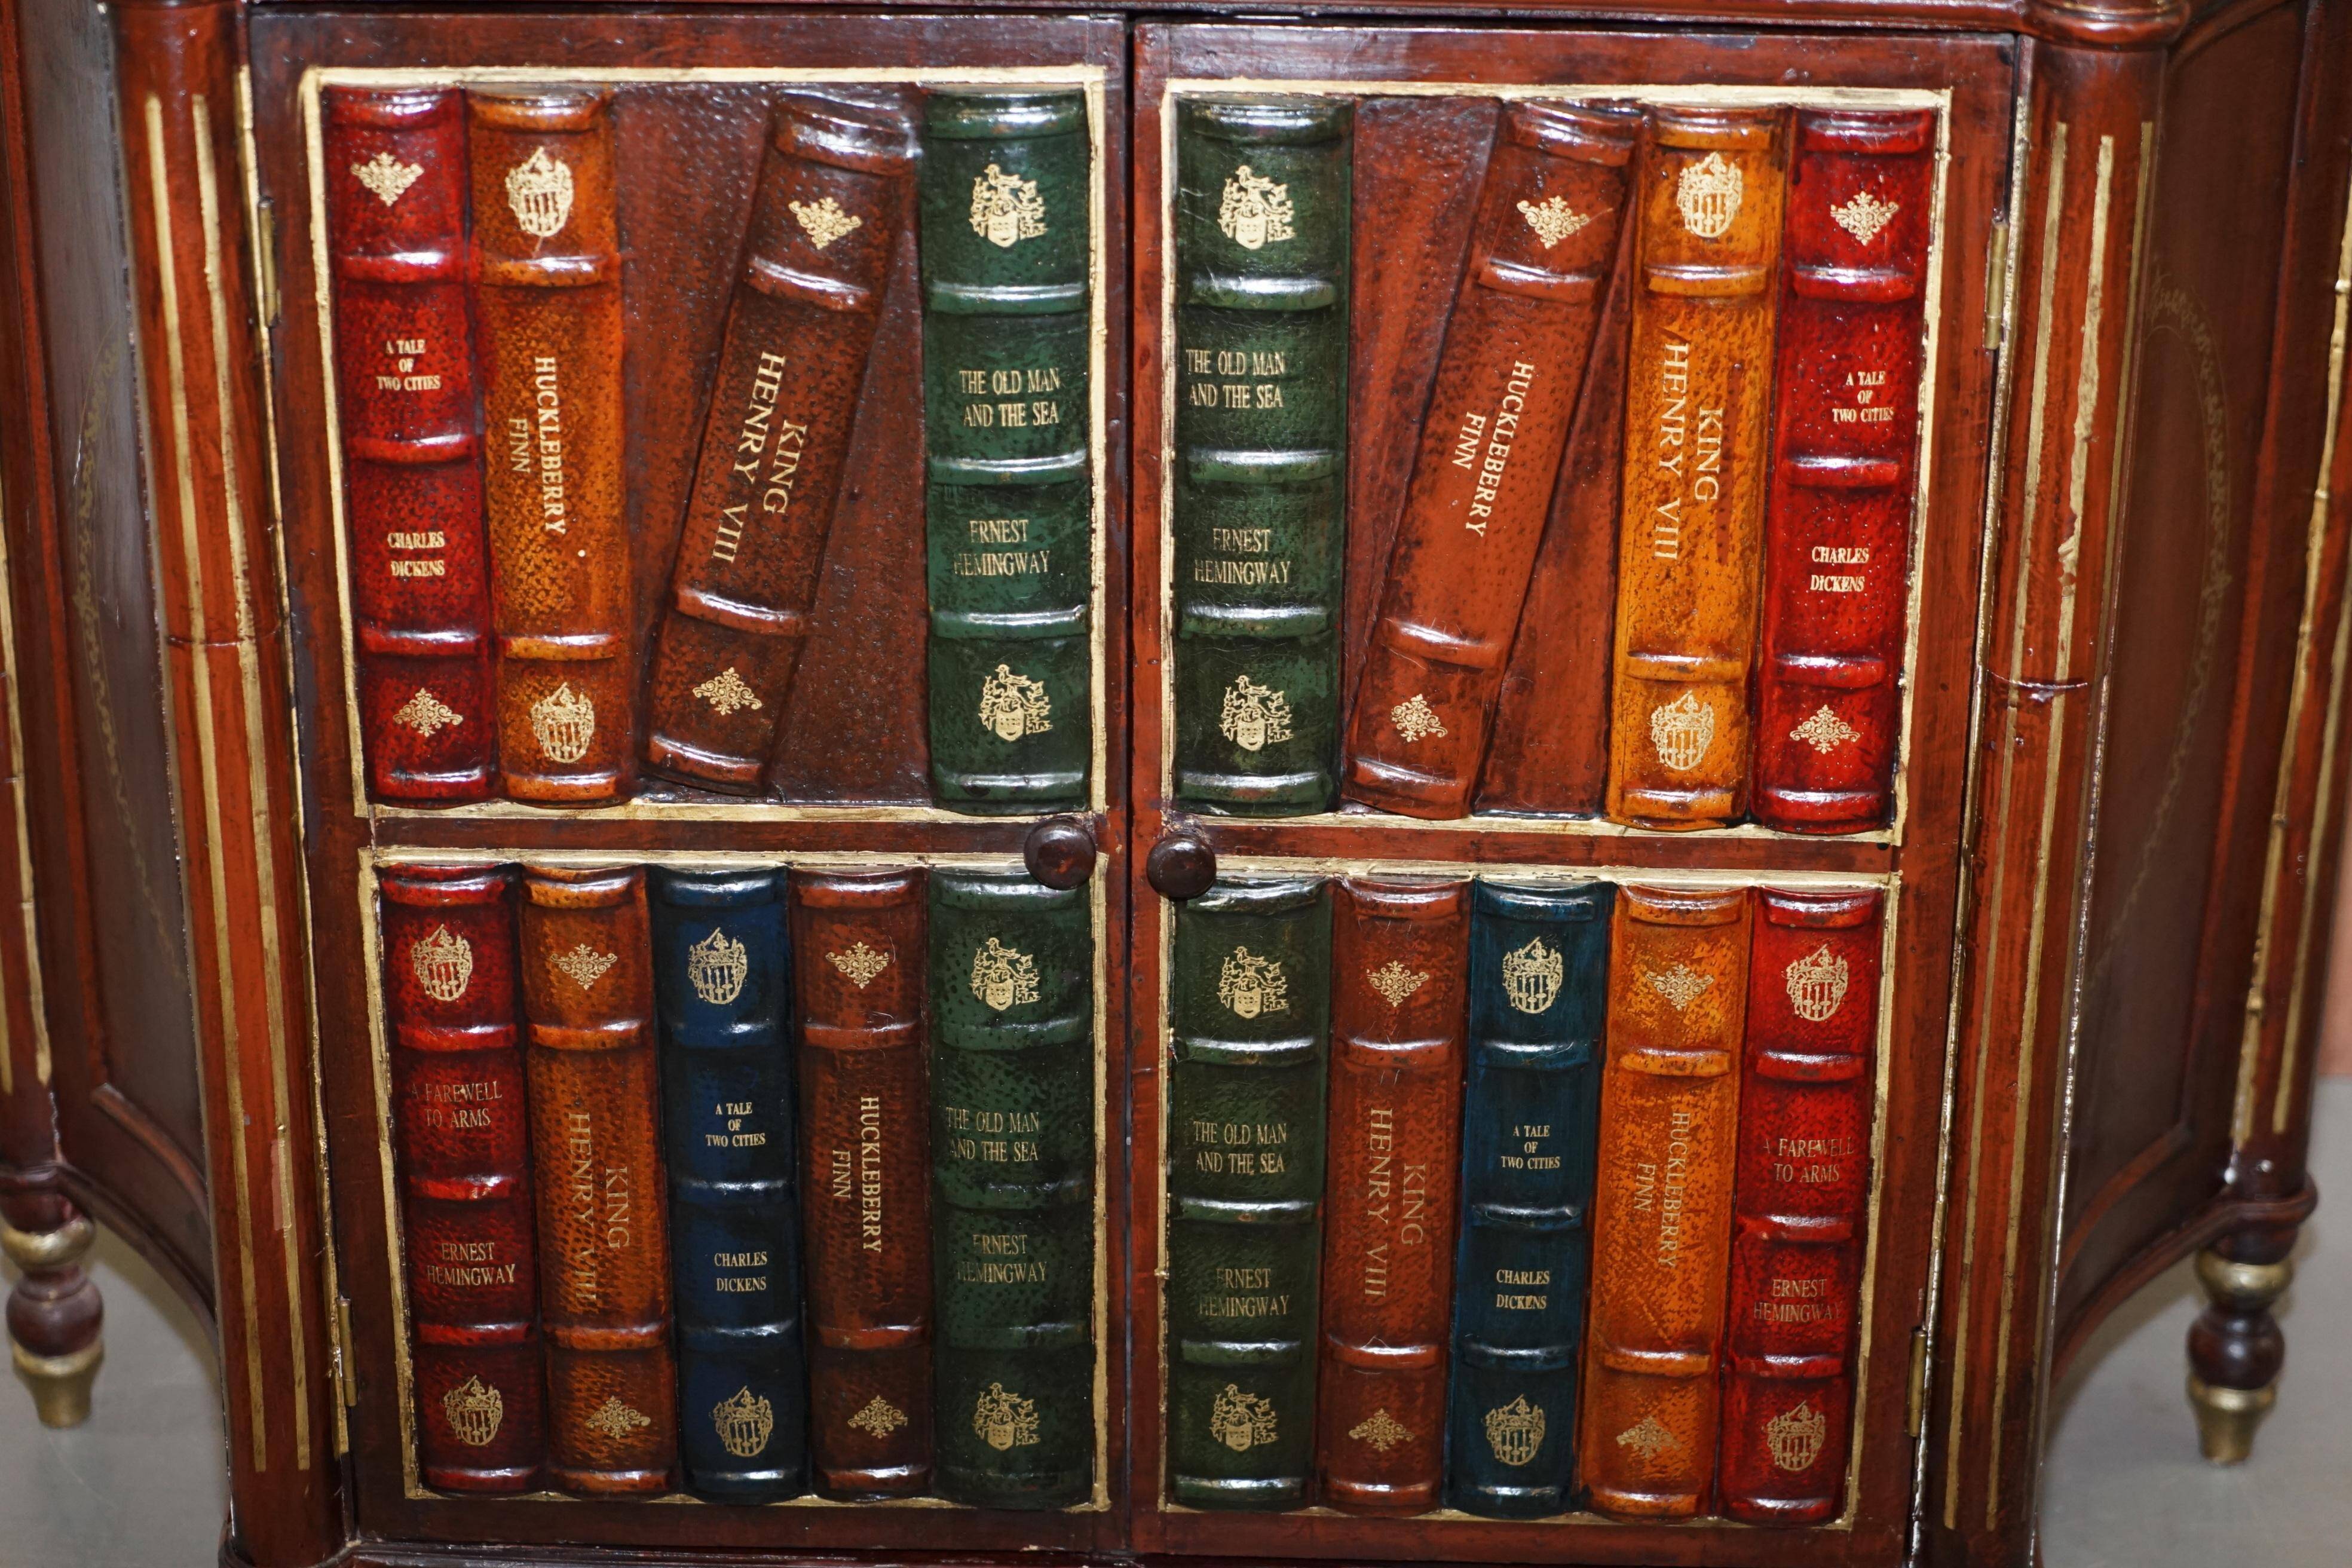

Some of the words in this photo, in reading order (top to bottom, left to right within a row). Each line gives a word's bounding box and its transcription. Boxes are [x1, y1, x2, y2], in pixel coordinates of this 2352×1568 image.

[385, 341, 392, 354] A
[396, 339, 426, 354] TALE
[399, 359, 414, 372] OF
[1187, 349, 1211, 375] THE
[1218, 351, 1245, 376] OLD
[1252, 352, 1285, 376] MAN
[376, 376, 401, 390] TWO
[404, 376, 440, 390] CITIES
[960, 370, 987, 393] THE
[993, 369, 1022, 395] OLD
[1028, 368, 1060, 391] MAN
[1846, 372, 1853, 385] A
[1858, 372, 1885, 385] TALE
[1190, 385, 1217, 406] AND
[1223, 385, 1250, 408] THE
[1257, 384, 1283, 408] SEA
[1858, 391, 1872, 404] OF
[733, 351, 786, 483] HENRY
[964, 404, 993, 426] AND
[999, 404, 1027, 427] THE
[1032, 402, 1059, 425] SEA
[1659, 343, 1689, 478] HENRY
[1832, 409, 1856, 422] TWO
[1861, 408, 1894, 422] CITIES
[509, 418, 531, 474] FINN
[535, 357, 566, 535] HUCKLEBERRY
[1452, 412, 1486, 470] FINN
[1465, 360, 1535, 537] HUCKLEBERRY
[1695, 408, 1724, 502] KING
[762, 419, 809, 514] KING
[712, 504, 748, 563] VIII
[970, 519, 1028, 543] ERNEST
[1213, 528, 1270, 552] ERNEST
[1654, 498, 1680, 560] VIII
[387, 532, 445, 549] CHARLES
[954, 551, 1049, 576] HEMINGWAY
[1812, 547, 1869, 564] CHARLES
[391, 561, 445, 577] DICKENS
[1195, 559, 1290, 584] HEMINGWAY
[1811, 575, 1865, 592] DICKENS
[425, 1081, 502, 1102] FAREWELL
[425, 1110, 442, 1128] TO
[450, 1108, 491, 1128] ARMS
[715, 1104, 722, 1115] A
[727, 1102, 752, 1115] TALE
[728, 1120, 741, 1131] OF
[947, 1107, 969, 1129] THE
[976, 1111, 1003, 1133] OLD
[1009, 1111, 1039, 1133] MAN
[1513, 1126, 1520, 1137] A
[1524, 1125, 1549, 1137] TALE
[705, 1135, 728, 1147] TWO
[733, 1133, 765, 1147] CITIES
[1194, 1121, 1217, 1143] THE
[1224, 1123, 1250, 1145] OLD
[1257, 1123, 1287, 1144] MAN
[951, 1140, 975, 1160] AND
[982, 1142, 1007, 1162] THE
[1014, 1142, 1038, 1162] SEA
[1524, 1141, 1538, 1153] OF
[1779, 1137, 1854, 1157] FAREWELL
[569, 1112, 594, 1228] HENRY
[1196, 1153, 1223, 1172] AND
[1228, 1153, 1254, 1175] THE
[1260, 1153, 1285, 1174] SEA
[1368, 1108, 1392, 1224] HENRY
[1501, 1156, 1524, 1169] TWO
[1527, 1156, 1560, 1169] CITIES
[1774, 1163, 1793, 1183] TO
[1800, 1163, 1839, 1183] ARMS
[833, 1150, 850, 1198] FINN
[861, 1097, 881, 1253] HUCKLEBERRY
[1634, 1162, 1656, 1212] FINN
[1658, 1113, 1690, 1268] HUCKLEBERRY
[605, 1166, 629, 1249] KING
[1401, 1163, 1426, 1246] KING
[441, 1242, 494, 1261] ERNEST
[973, 1235, 1027, 1255] ERNEST
[714, 1252, 767, 1267] CHARLES
[1365, 1242, 1388, 1297] VIII
[427, 1264, 515, 1285] HEMINGWAY
[571, 1247, 596, 1300] VIII
[716, 1276, 766, 1291] DICKENS
[1217, 1268, 1270, 1288] ERNEST
[1496, 1269, 1549, 1285] CHARLES
[1772, 1278, 1827, 1298] ERNEST
[1496, 1295, 1547, 1309] DICKENS
[1754, 1301, 1844, 1322] HEMINGWAY
